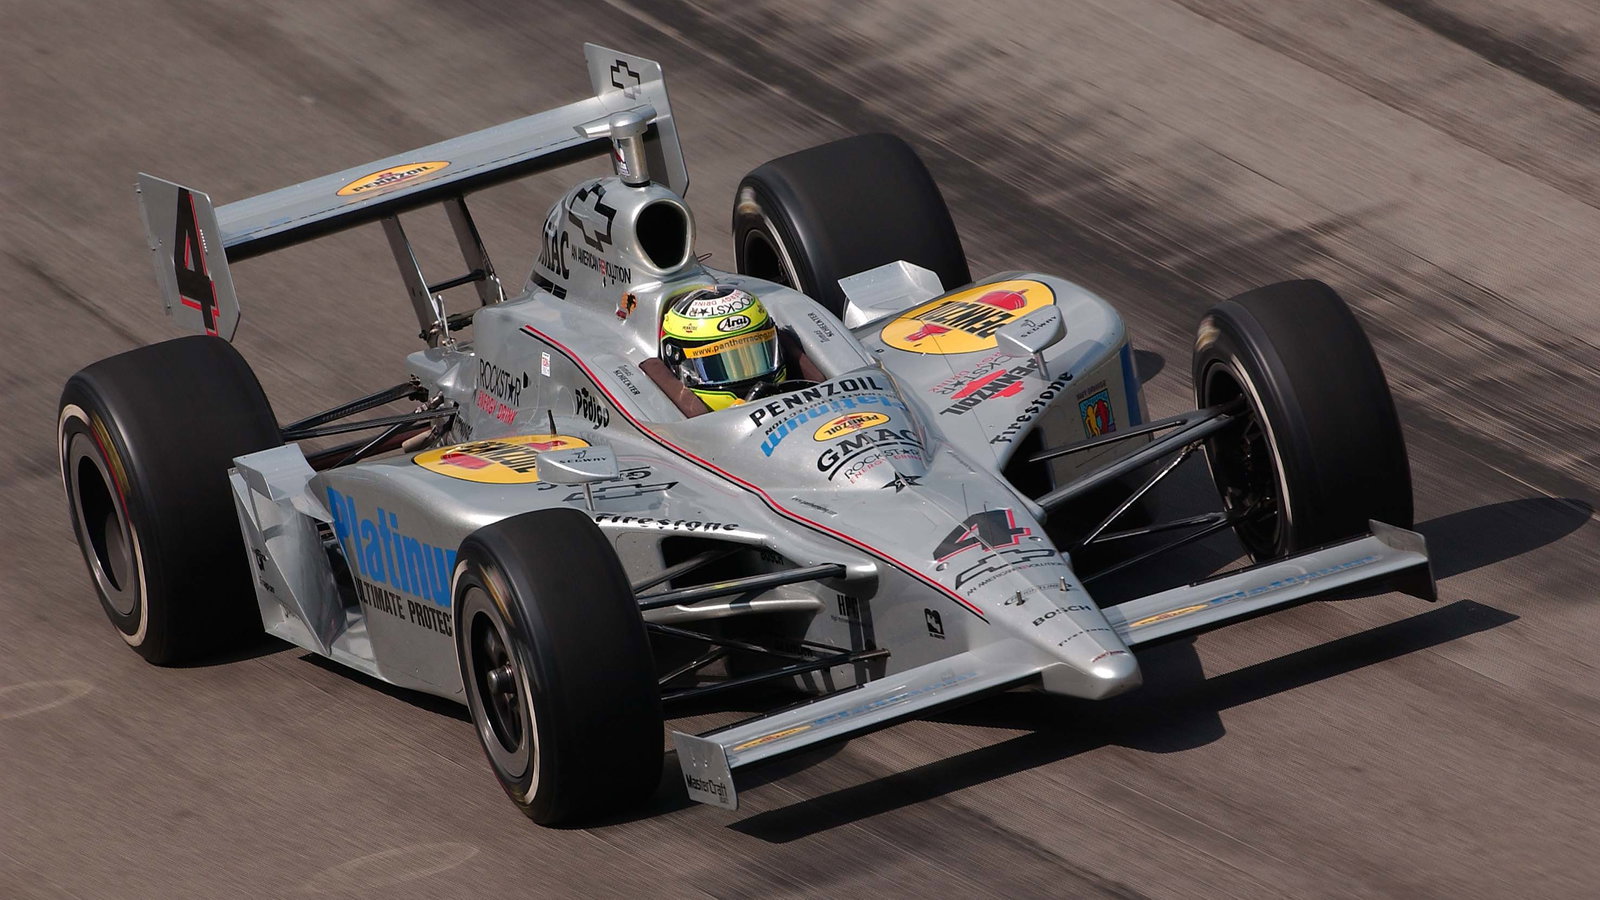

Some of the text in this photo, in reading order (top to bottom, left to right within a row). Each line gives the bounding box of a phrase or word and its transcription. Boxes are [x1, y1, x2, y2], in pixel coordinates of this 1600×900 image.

[352, 166, 434, 192] PENNZOIL
[174, 187, 220, 337] 4
[721, 315, 748, 331] Arai
[1020, 316, 1057, 338] SEGWAY
[750, 376, 884, 428] PENNZOIL
[939, 358, 1040, 416] PENNZOIL
[824, 414, 880, 436] PENNZOIL
[990, 372, 1074, 445] Firestone
[817, 429, 922, 473] GMAC
[595, 513, 740, 532] Firestone
[933, 508, 1032, 562] 4
[326, 486, 458, 608] Platinu
[407, 600, 453, 637] PROTEC
[1032, 605, 1092, 627] BOSCH
[685, 774, 728, 798] MasterCraft
